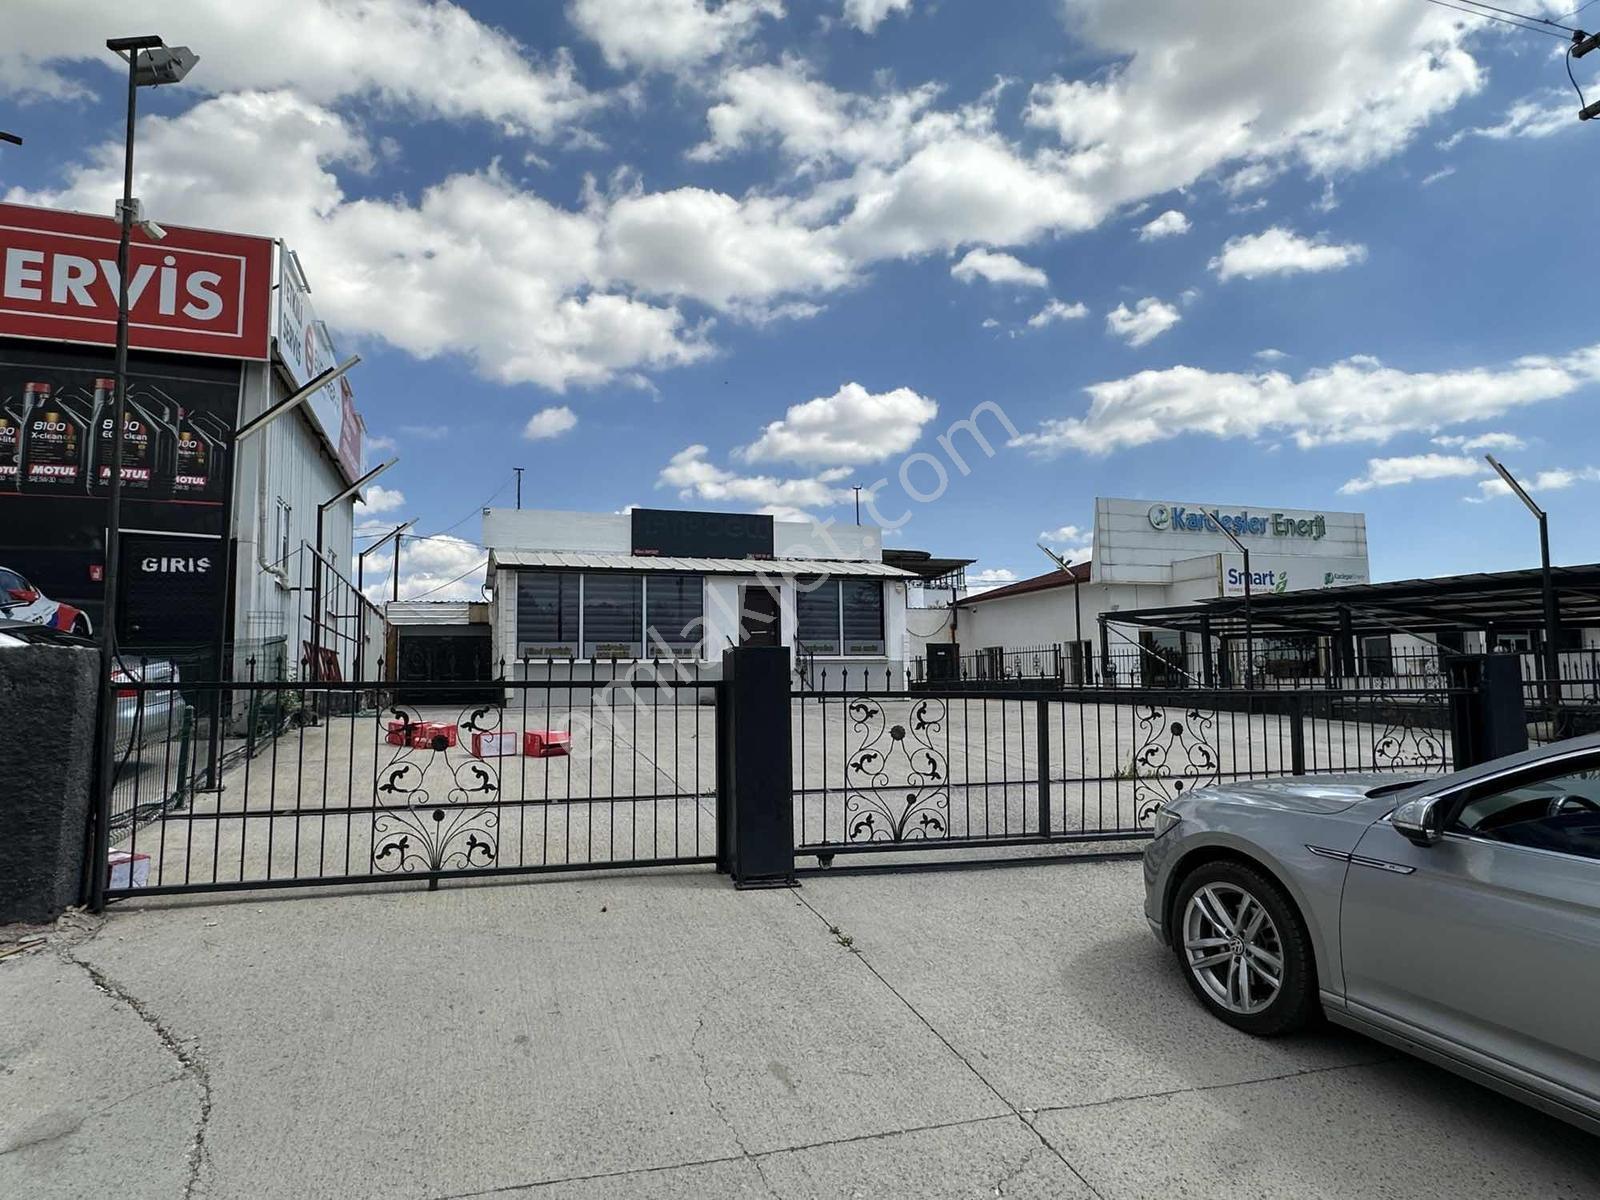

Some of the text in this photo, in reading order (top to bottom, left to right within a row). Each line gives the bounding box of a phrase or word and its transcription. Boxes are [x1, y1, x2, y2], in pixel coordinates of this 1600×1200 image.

[33, 421, 66, 431] 8100
[31, 465, 76, 476] MOTUL
[1271, 513, 1327, 541] Enerji
[1228, 568, 1276, 586] Smart
